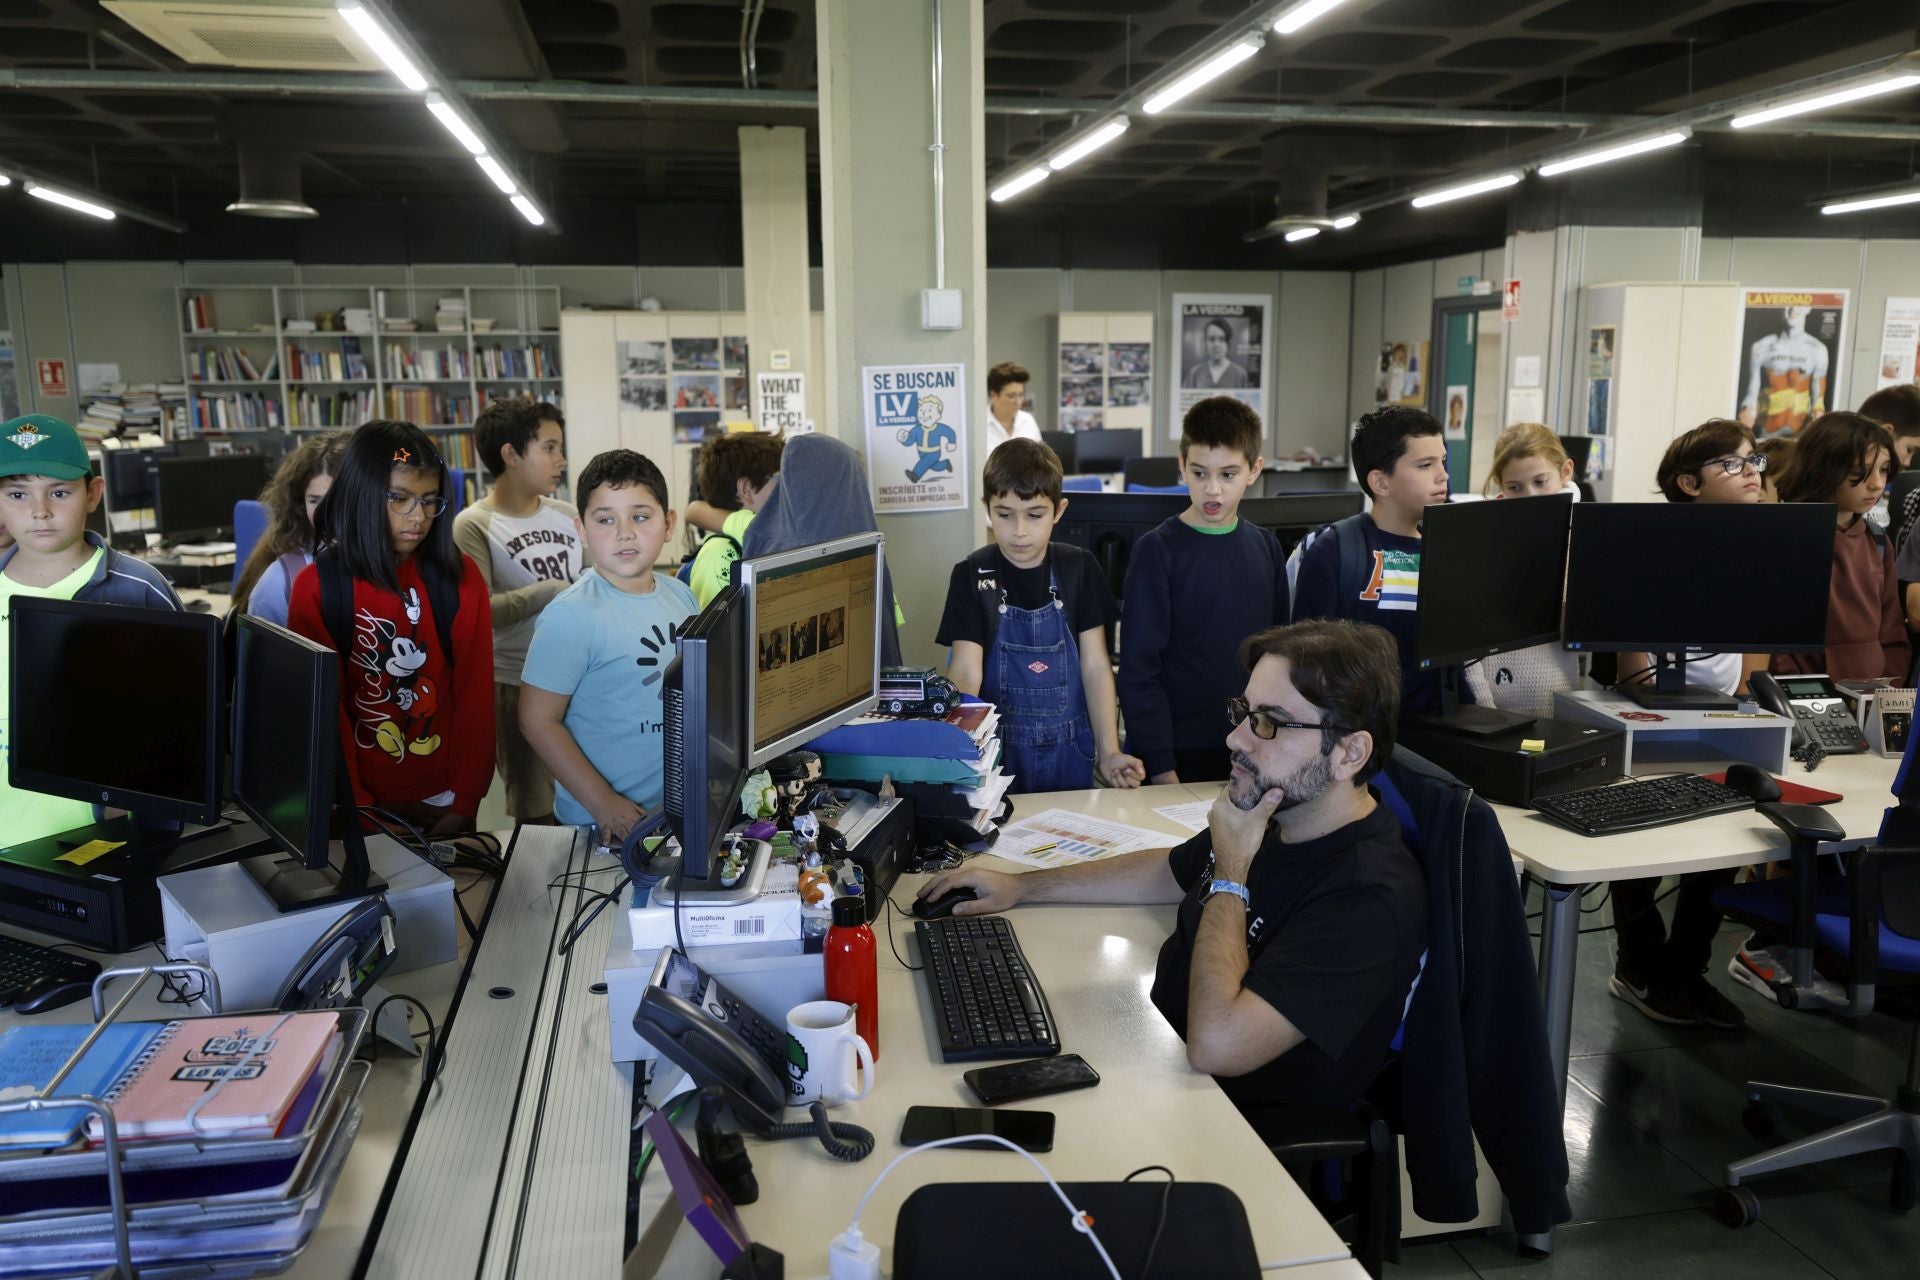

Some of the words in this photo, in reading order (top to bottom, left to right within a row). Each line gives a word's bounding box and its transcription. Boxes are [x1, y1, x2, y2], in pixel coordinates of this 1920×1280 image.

[1747, 293, 1762, 305] LA
[1763, 293, 1813, 305] VERDAD
[1183, 305, 1199, 316] LA
[1199, 305, 1244, 316] VERDAD
[761, 378, 801, 393] WHAT
[873, 373, 891, 390] SE
[896, 371, 955, 389] BUSCAN
[761, 395, 787, 410] THE
[880, 394, 912, 417] LV
[879, 484, 926, 495] INSCRÍBETE
[938, 484, 945, 492] la
[879, 495, 907, 504] CARRERA
[908, 495, 916, 503] DE
[916, 494, 946, 503] EMPRESAS
[350, 608, 404, 764] Mickey
[640, 719, 664, 734] I'm
